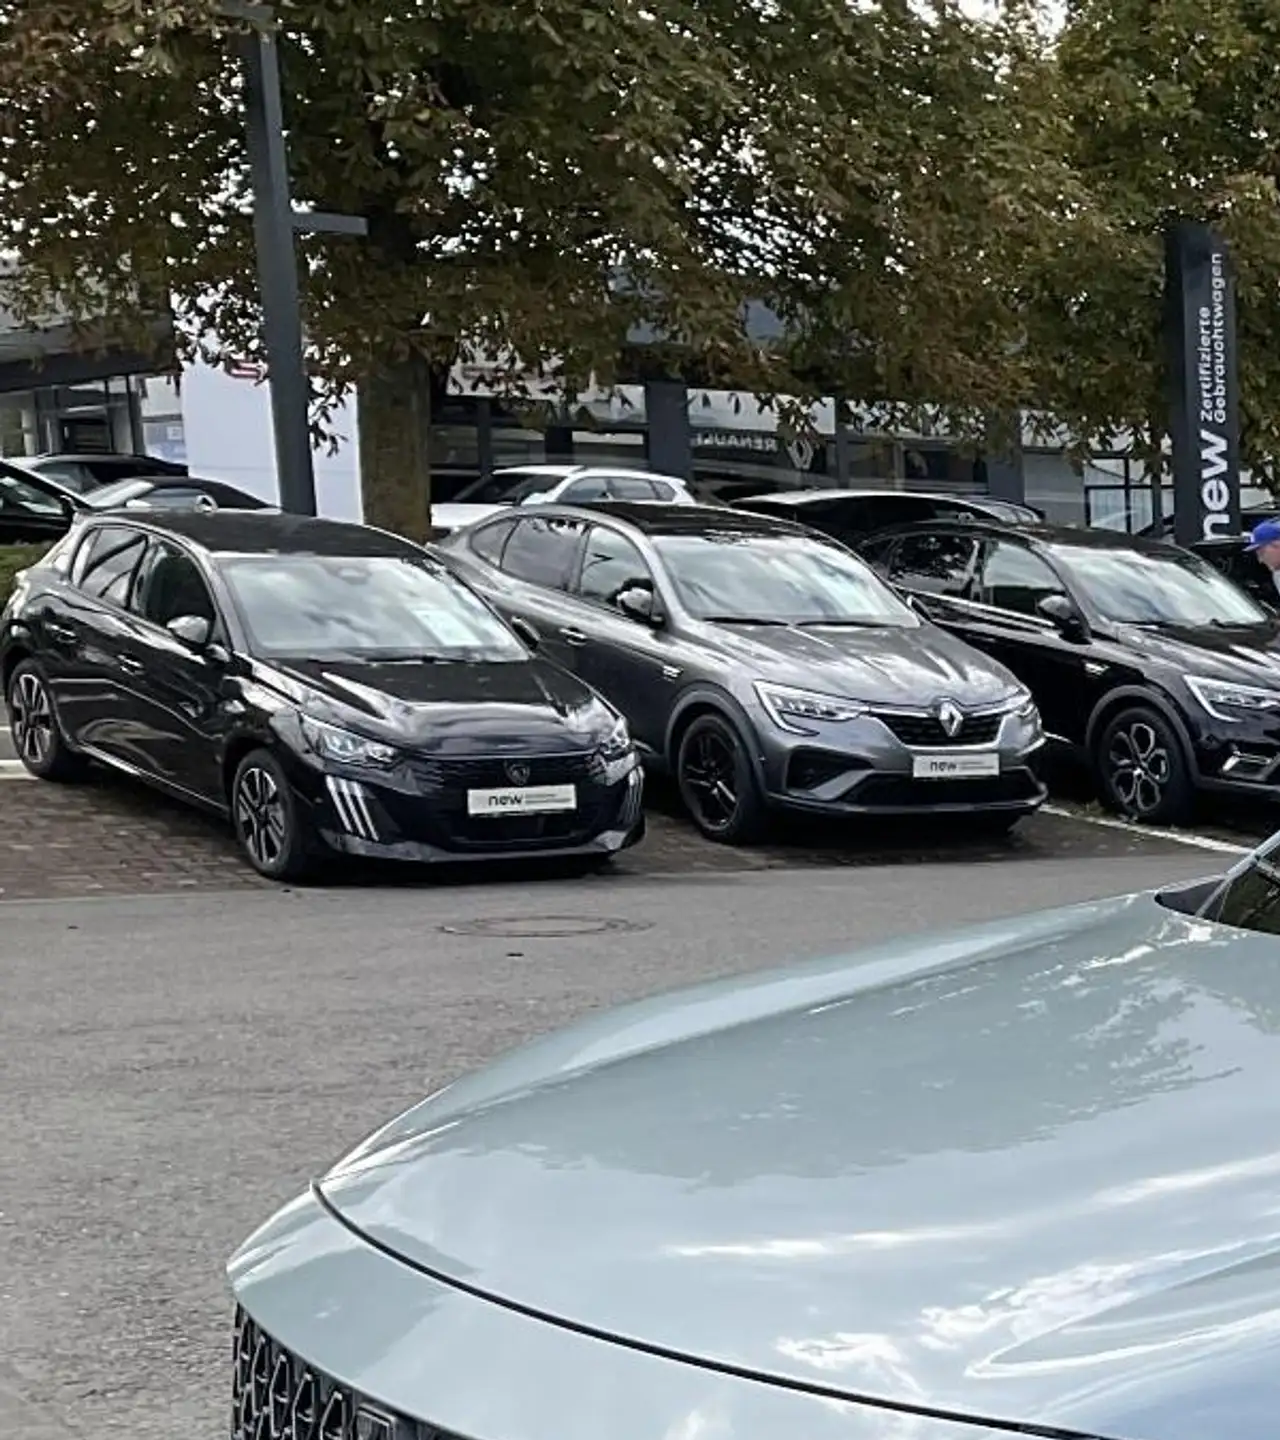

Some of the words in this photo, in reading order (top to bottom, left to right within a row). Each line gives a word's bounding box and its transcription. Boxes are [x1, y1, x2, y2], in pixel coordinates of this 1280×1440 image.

[1199, 306, 1213, 422] Zertifizierte
[1211, 253, 1226, 424] Gebrauchtwagen
[1200, 429, 1230, 541] new
